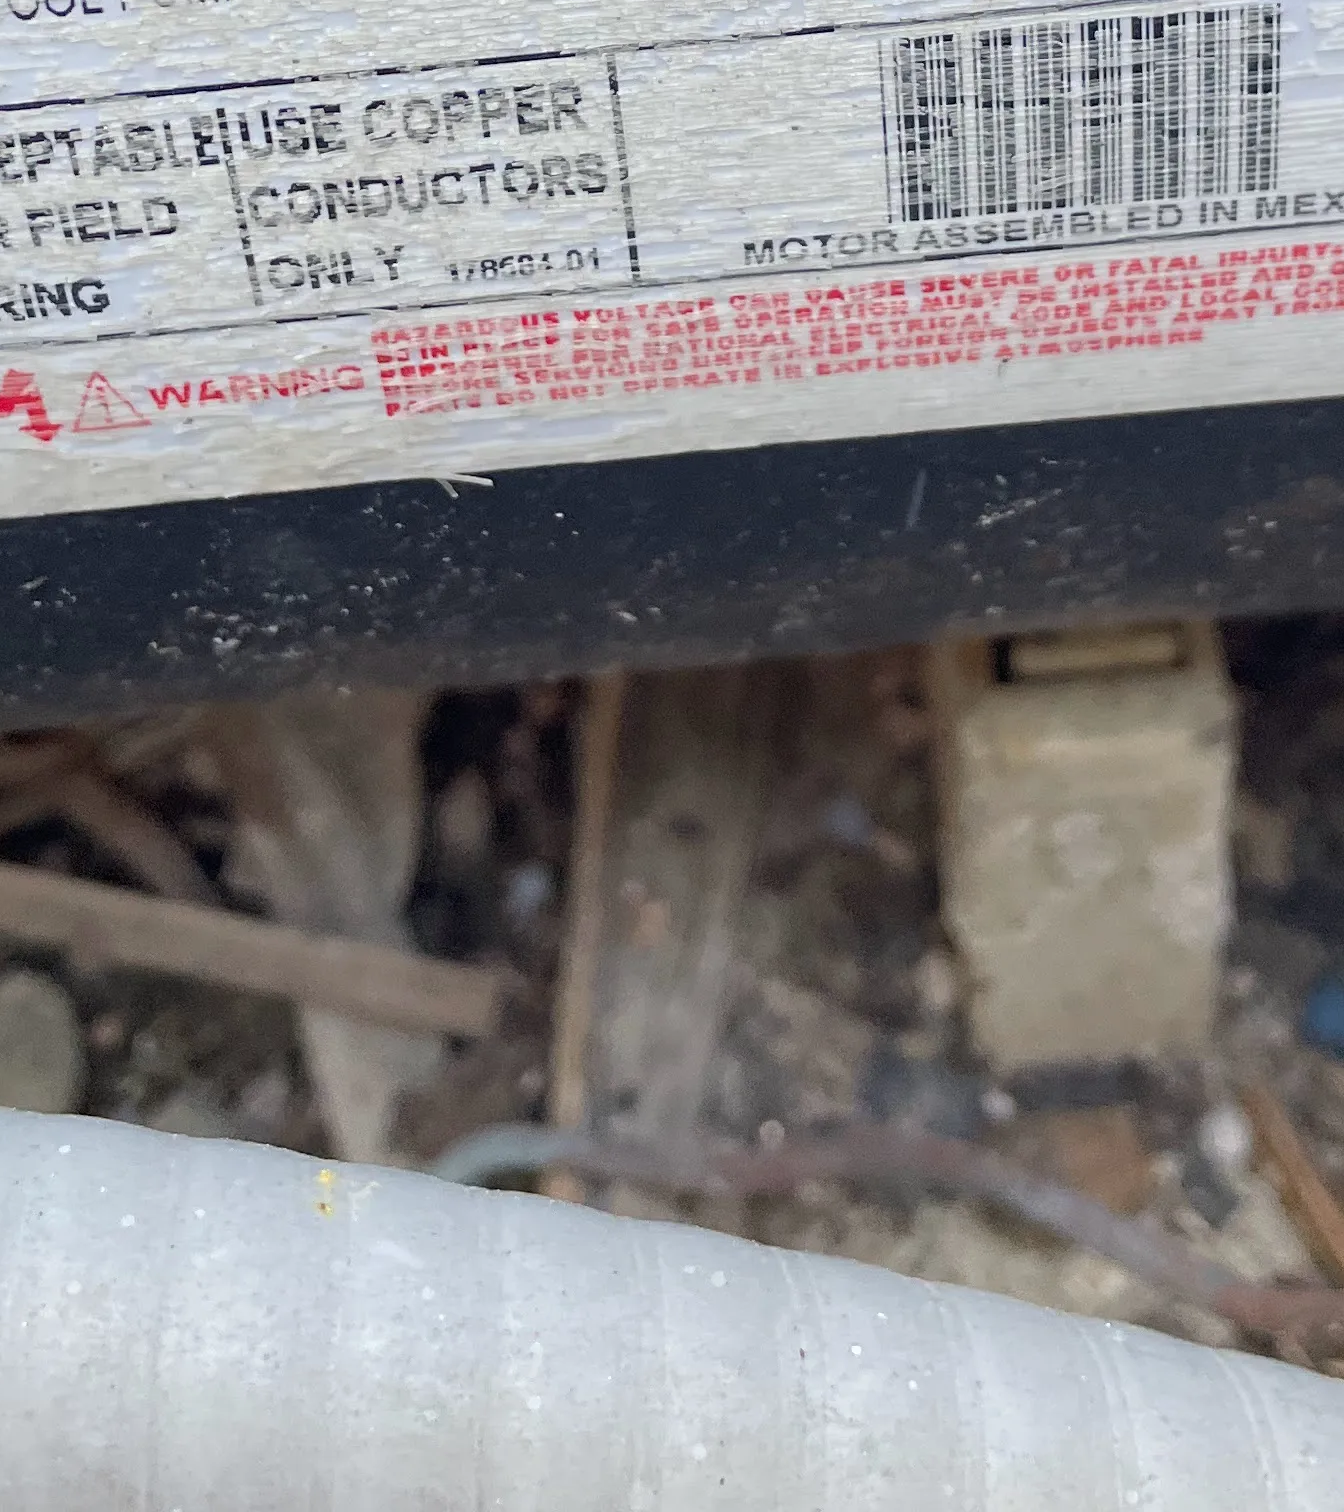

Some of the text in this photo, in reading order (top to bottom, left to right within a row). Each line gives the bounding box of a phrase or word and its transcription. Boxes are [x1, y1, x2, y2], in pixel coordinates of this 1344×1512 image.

[237, 80, 585, 157] USE COPPER
[247, 152, 609, 227] CONDUCTORS
[25, 196, 179, 247] FIELD
[742, 224, 900, 268] MOTOR
[916, 201, 1185, 254] ASSEMBLED
[1198, 196, 1240, 226] IN
[267, 244, 406, 289] ONLY
[1109, 254, 1203, 277] FATAL
[147, 364, 366, 411] WARNING
